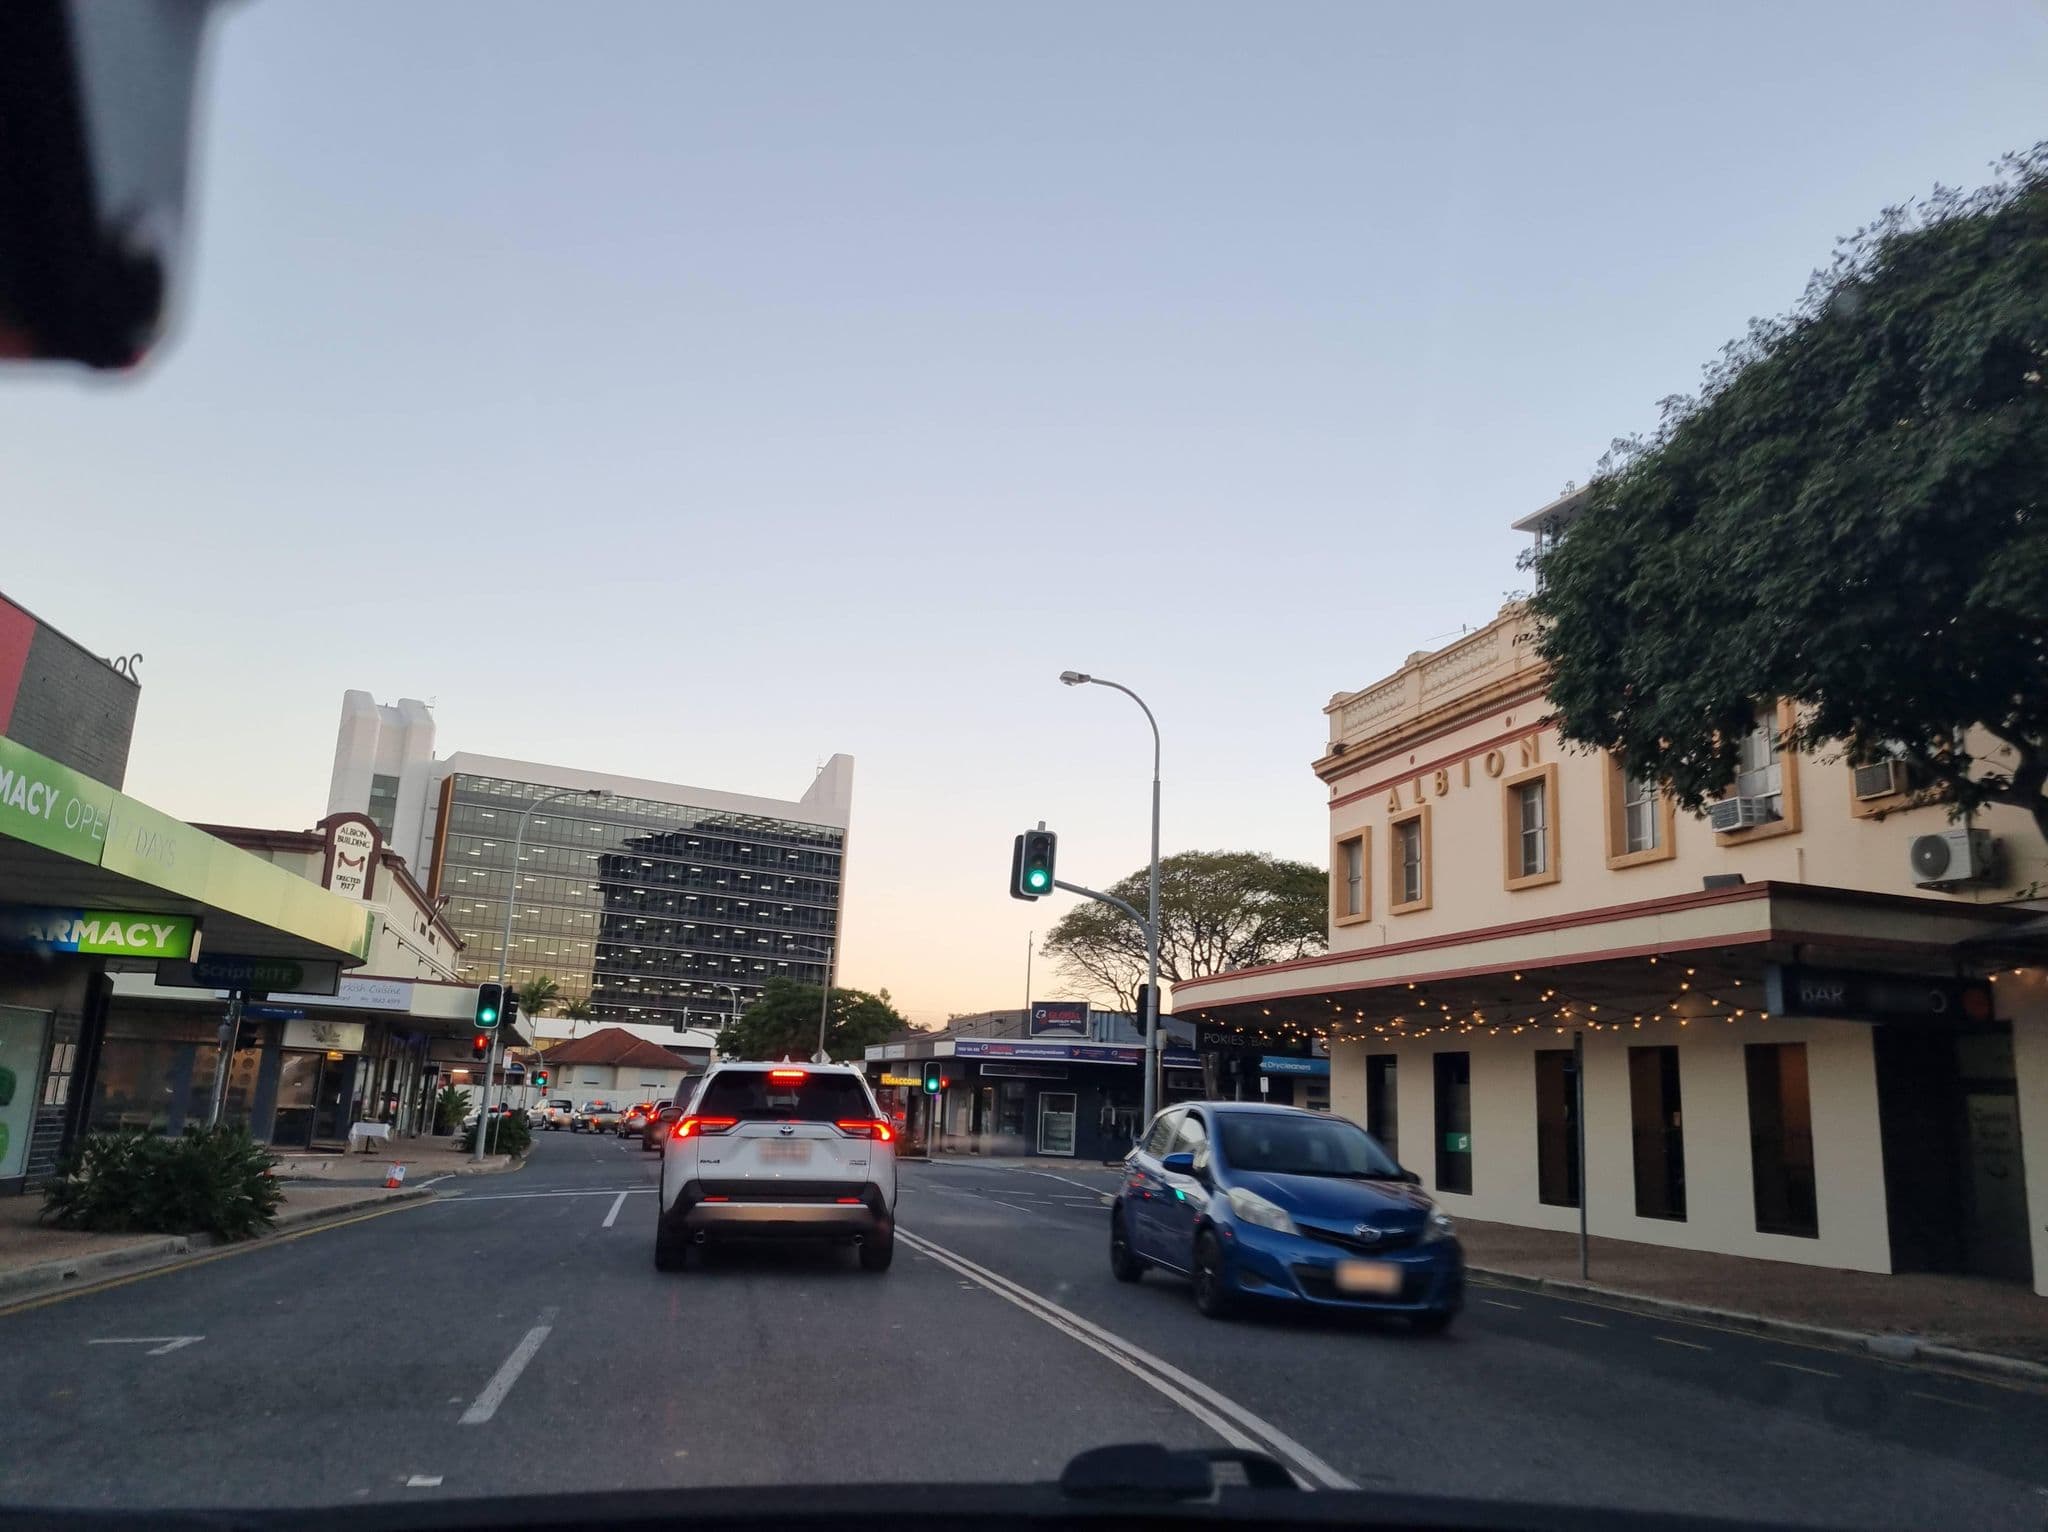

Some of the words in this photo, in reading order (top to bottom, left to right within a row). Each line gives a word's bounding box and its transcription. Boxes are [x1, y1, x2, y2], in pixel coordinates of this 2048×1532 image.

[1387, 733, 1540, 813] ALBION
[341, 827, 367, 838] ALBION
[337, 835, 370, 849] BUILDING
[336, 874, 361, 884] ERECTED
[199, 962, 294, 984] ScriptRITE
